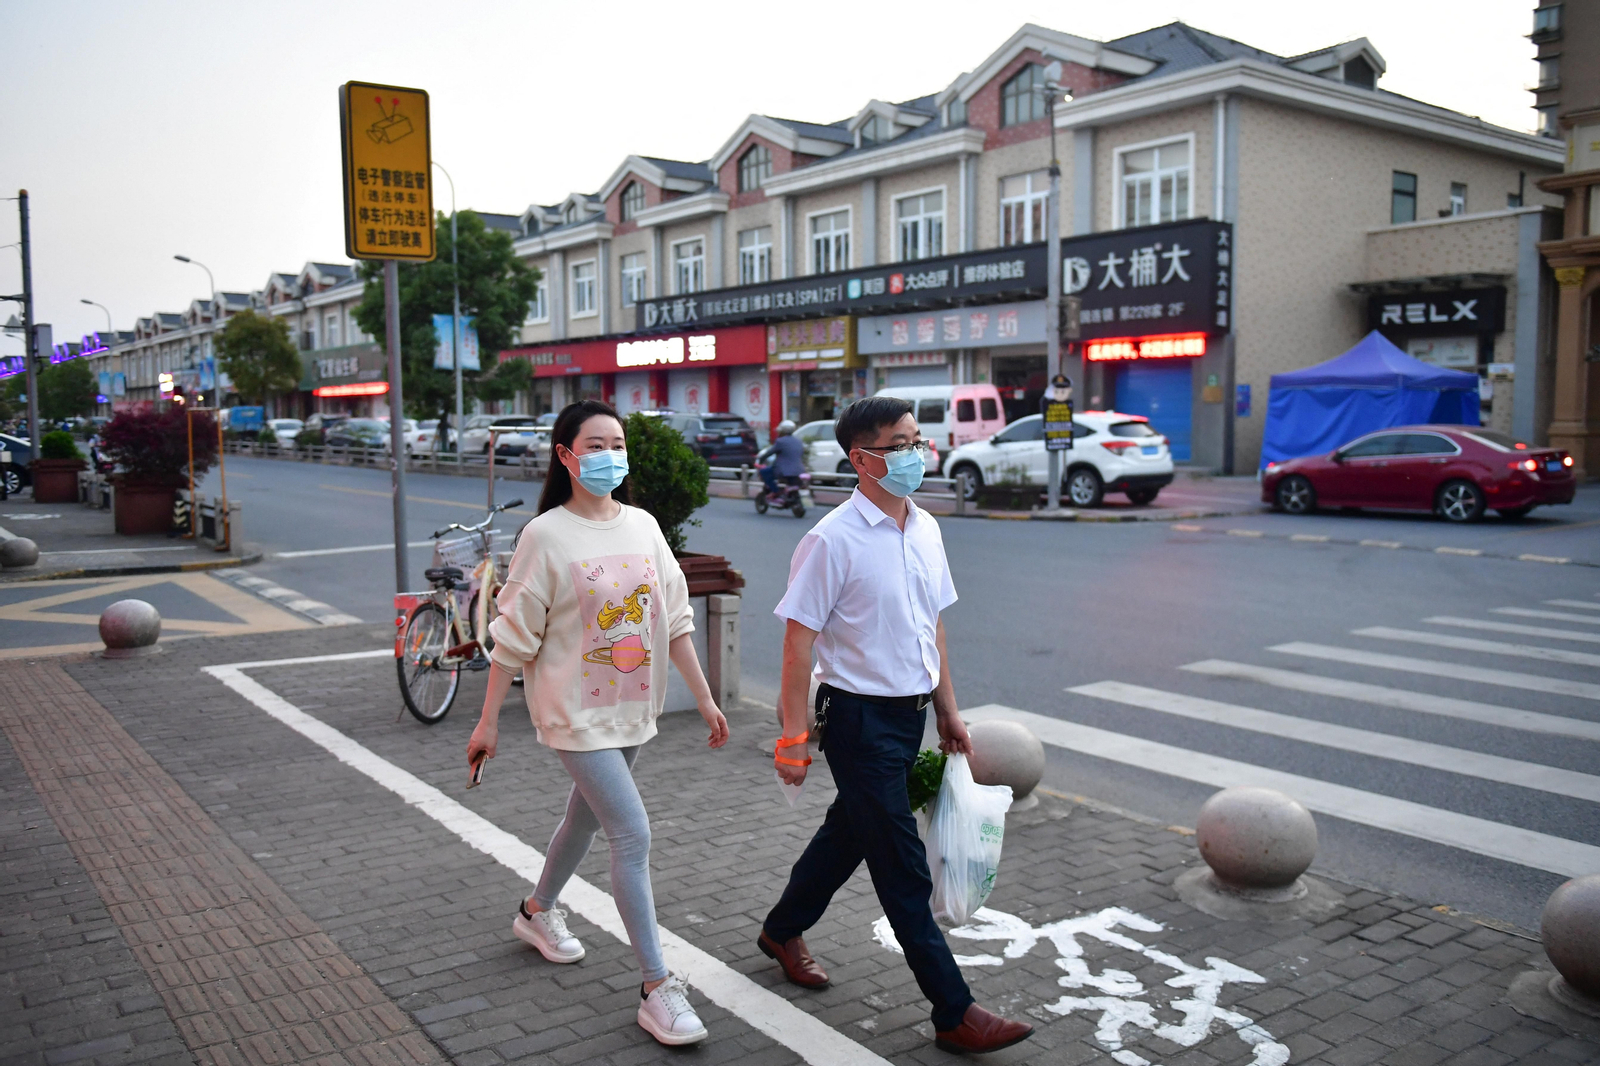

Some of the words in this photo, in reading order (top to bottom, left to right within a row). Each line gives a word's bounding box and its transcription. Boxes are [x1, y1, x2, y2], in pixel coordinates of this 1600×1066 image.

[358, 167, 426, 189] 电子警察监管
[359, 206, 427, 227] 停车行为违法
[366, 228, 423, 248] 请立即驶离
[1098, 243, 1191, 290] 大桶大
[905, 270, 949, 290] 大众点评
[1381, 298, 1479, 326] RELX
